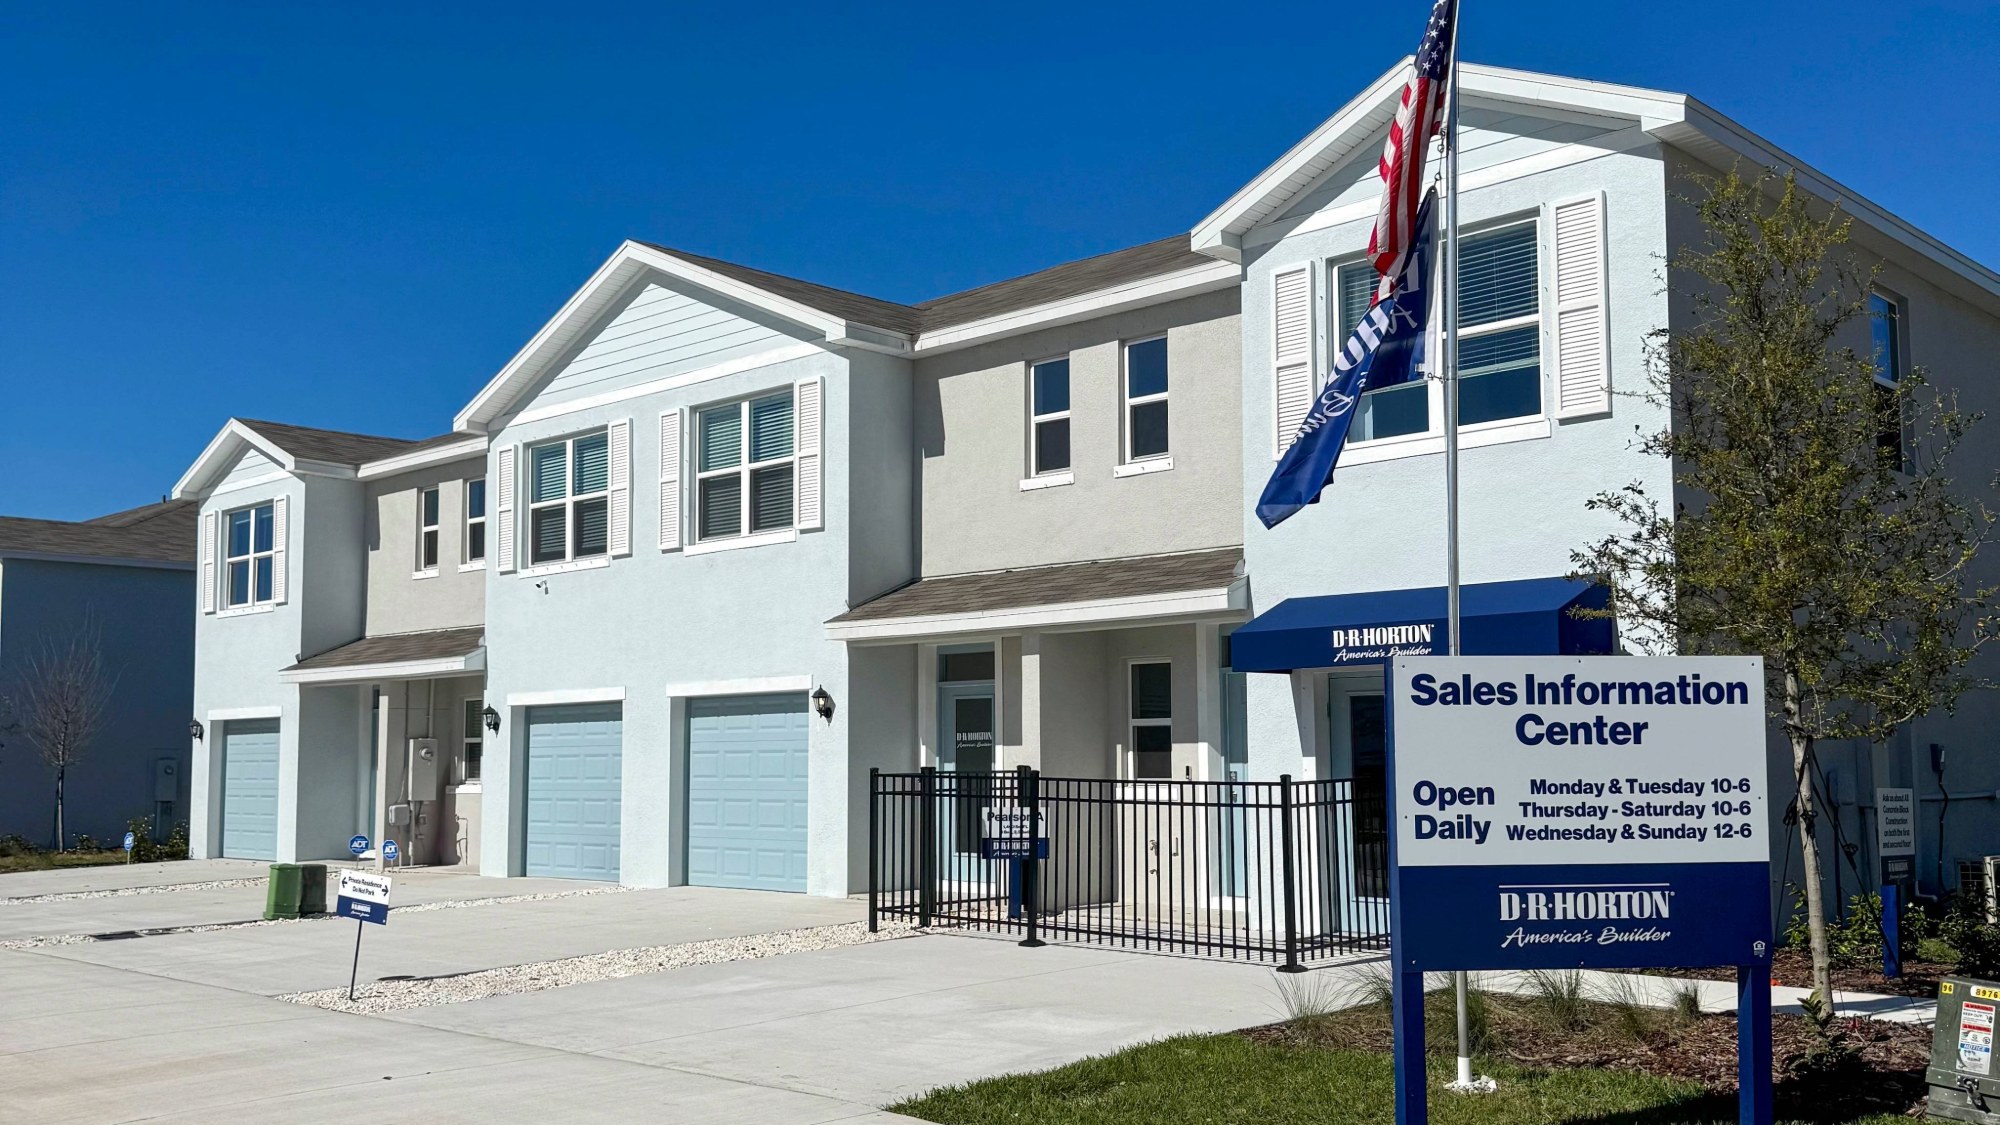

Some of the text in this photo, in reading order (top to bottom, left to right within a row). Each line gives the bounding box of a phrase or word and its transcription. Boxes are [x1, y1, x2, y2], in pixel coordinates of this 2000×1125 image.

[1333, 645, 1432, 662] America's Builder
[1410, 673, 1749, 706] Sales Information
[1515, 713, 1649, 746] Center
[1413, 780, 1495, 811] Open
[1530, 778, 1751, 797] Monday & Tuesday 10-6
[1519, 801, 1609, 820] Thursday
[1621, 800, 1706, 820] Saturday
[1711, 800, 1752, 816] 10-6
[1414, 814, 1491, 844] Daily
[1505, 822, 1752, 843] Wednesday & Sunday 12-6
[1501, 926, 1671, 948] America's Builder
[1943, 984, 1953, 993] 96
[1975, 988, 1998, 999] 8976
